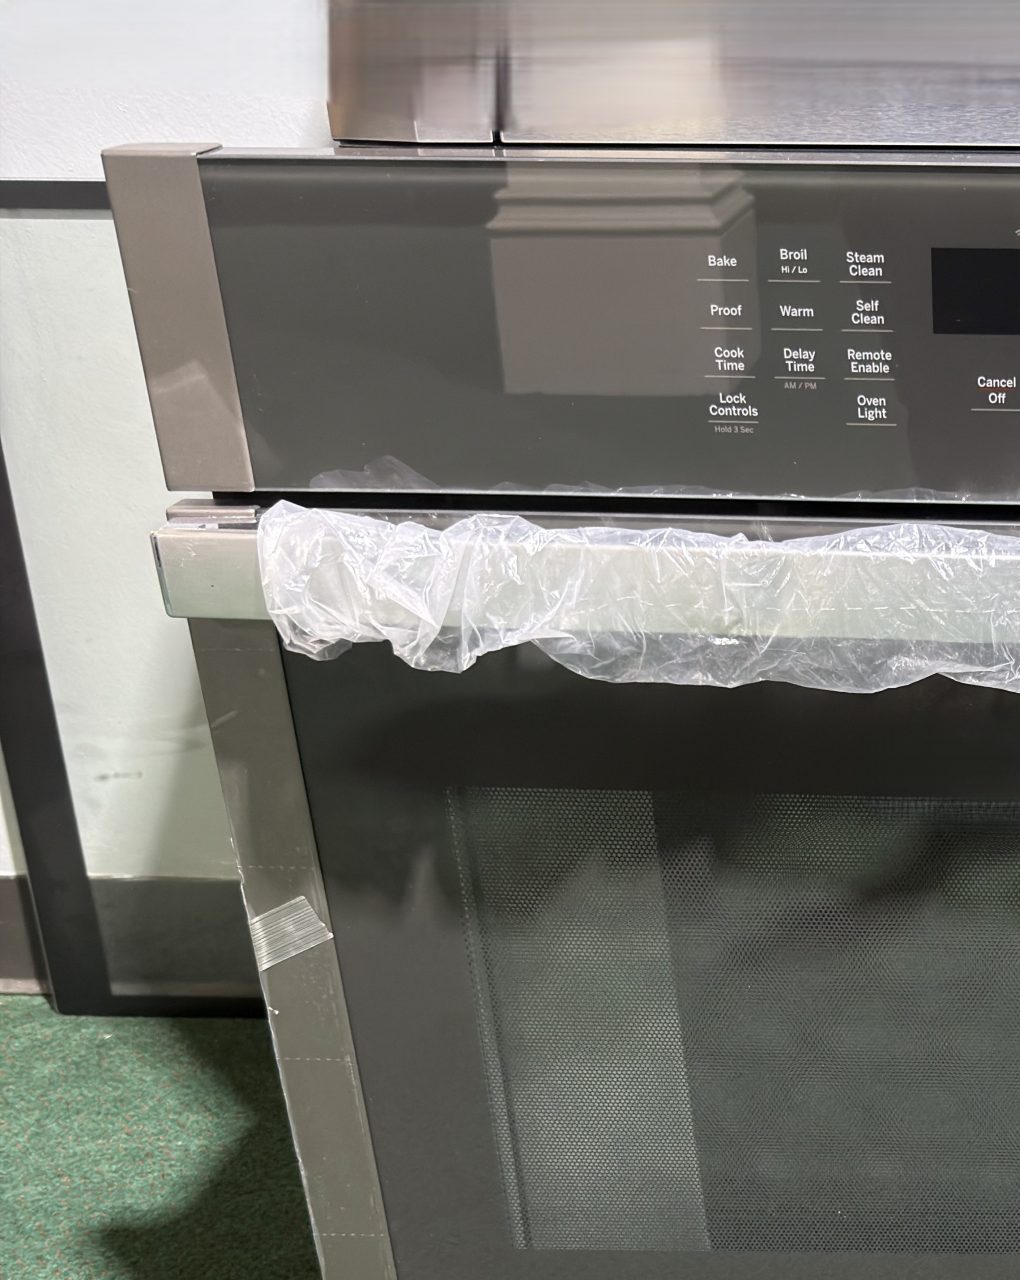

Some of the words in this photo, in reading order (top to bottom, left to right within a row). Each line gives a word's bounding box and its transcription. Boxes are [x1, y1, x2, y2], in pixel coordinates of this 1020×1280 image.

[780, 249, 808, 260] Broil
[846, 252, 885, 264] Steam
[708, 255, 737, 267] Bake
[781, 266, 789, 274] Hi
[849, 265, 883, 276] Clean
[710, 304, 742, 316] Proof
[780, 305, 814, 317] Warm
[856, 300, 879, 312] Self
[851, 313, 884, 325] Clean
[714, 347, 744, 359] Cook
[784, 348, 815, 361] Delay
[847, 349, 892, 361] Remote
[715, 360, 745, 371] Time
[785, 361, 815, 372] Time
[851, 362, 890, 373] Enable
[977, 376, 1016, 388] Cancel
[719, 393, 746, 404] Lock
[857, 395, 886, 406] Oven
[988, 392, 1006, 404] Off
[709, 405, 758, 417] Controls
[858, 408, 887, 421] Light
[740, 426, 754, 434] Sec
